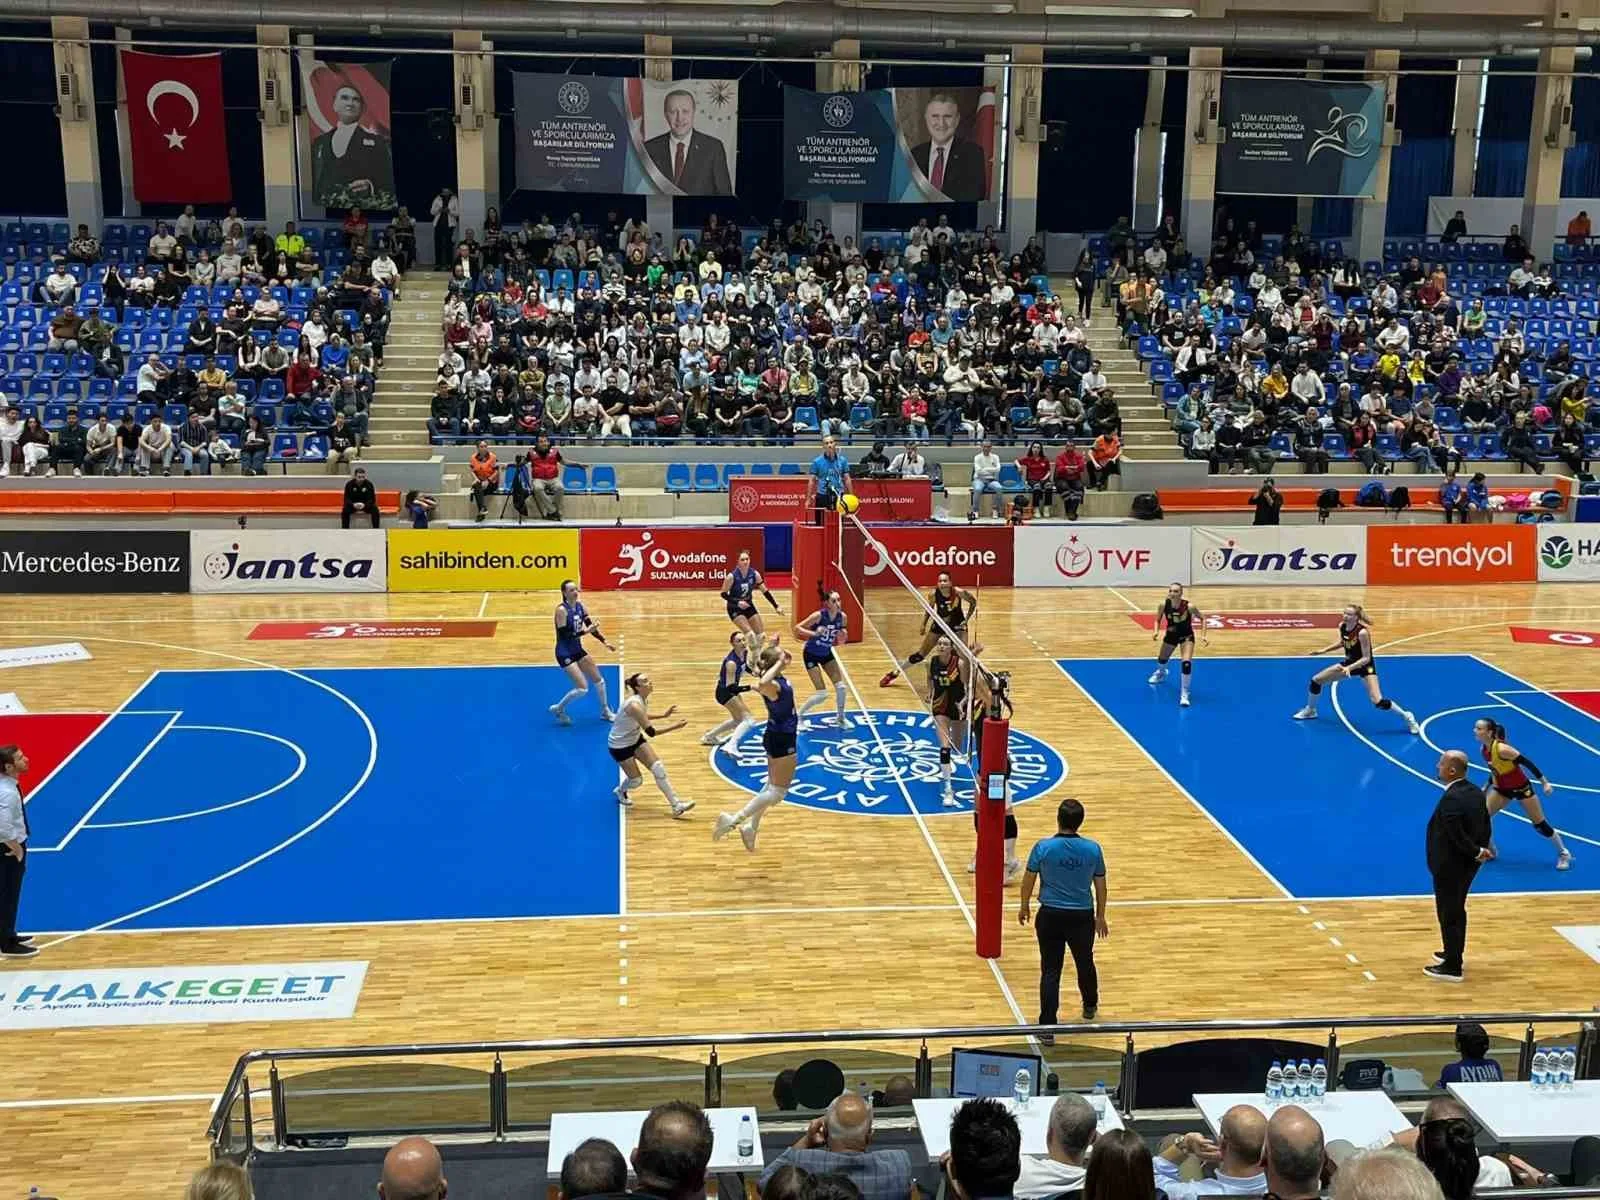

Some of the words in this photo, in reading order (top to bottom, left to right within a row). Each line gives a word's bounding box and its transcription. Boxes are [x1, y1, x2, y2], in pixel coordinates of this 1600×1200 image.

[531, 129, 542, 138] VE
[806, 135, 825, 145] TÜM
[826, 136, 870, 146] ANTRENÖR
[797, 145, 806, 154] VE
[808, 145, 879, 155] SPORCULARIMIZA
[1, 551, 181, 574] Mercedes-Benz
[400, 551, 567, 570] sahibinden.com
[672, 552, 727, 564] vodafone
[894, 545, 996, 567] vodafone
[1098, 549, 1152, 570] TVF
[1391, 541, 1513, 571] trendyol
[650, 570, 705, 580] SULTANLAR
[708, 569, 727, 580] LİGİ
[16, 975, 346, 1004] HALKEGEET
[1459, 1064, 1499, 1082] AYDIN
